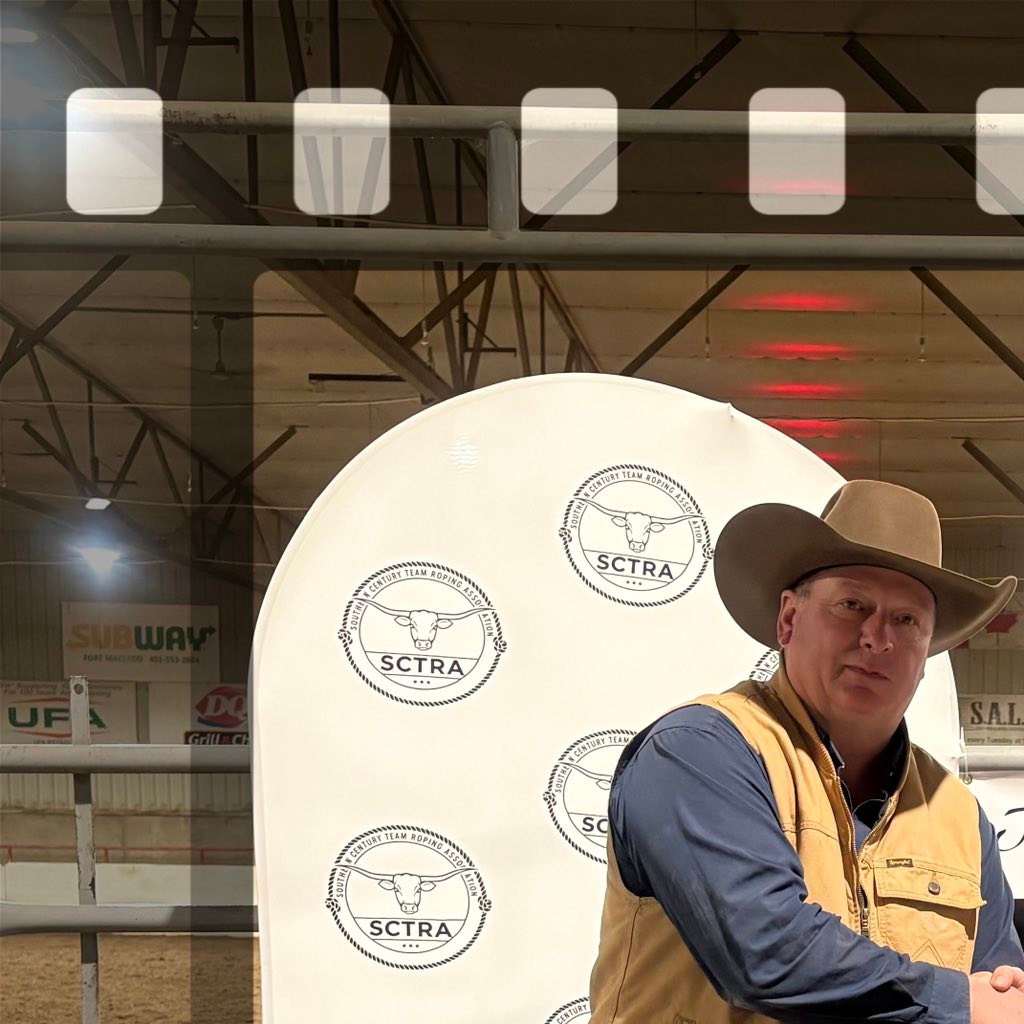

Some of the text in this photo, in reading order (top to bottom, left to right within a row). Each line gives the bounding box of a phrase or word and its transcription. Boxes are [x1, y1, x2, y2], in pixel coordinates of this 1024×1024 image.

[571, 471, 703, 544] SOUTHEN CENTURY TEAM ROPING ASSOATION
[596, 554, 674, 580] SCTRA
[350, 569, 494, 637] SOUTHEN CENTURY TEAM ROPING ASSOATION
[66, 624, 216, 651] SUBWAY
[380, 654, 465, 676] SCTRA
[188, 732, 222, 745] Grill
[555, 736, 630, 793] SOUTHEN CENTURY TEAM
[336, 832, 477, 898] SOUTHEN CENTURY TEAM ROPING ASSOATION
[369, 920, 452, 938] SCTRA
[556, 1004, 587, 1024] CENTURY
